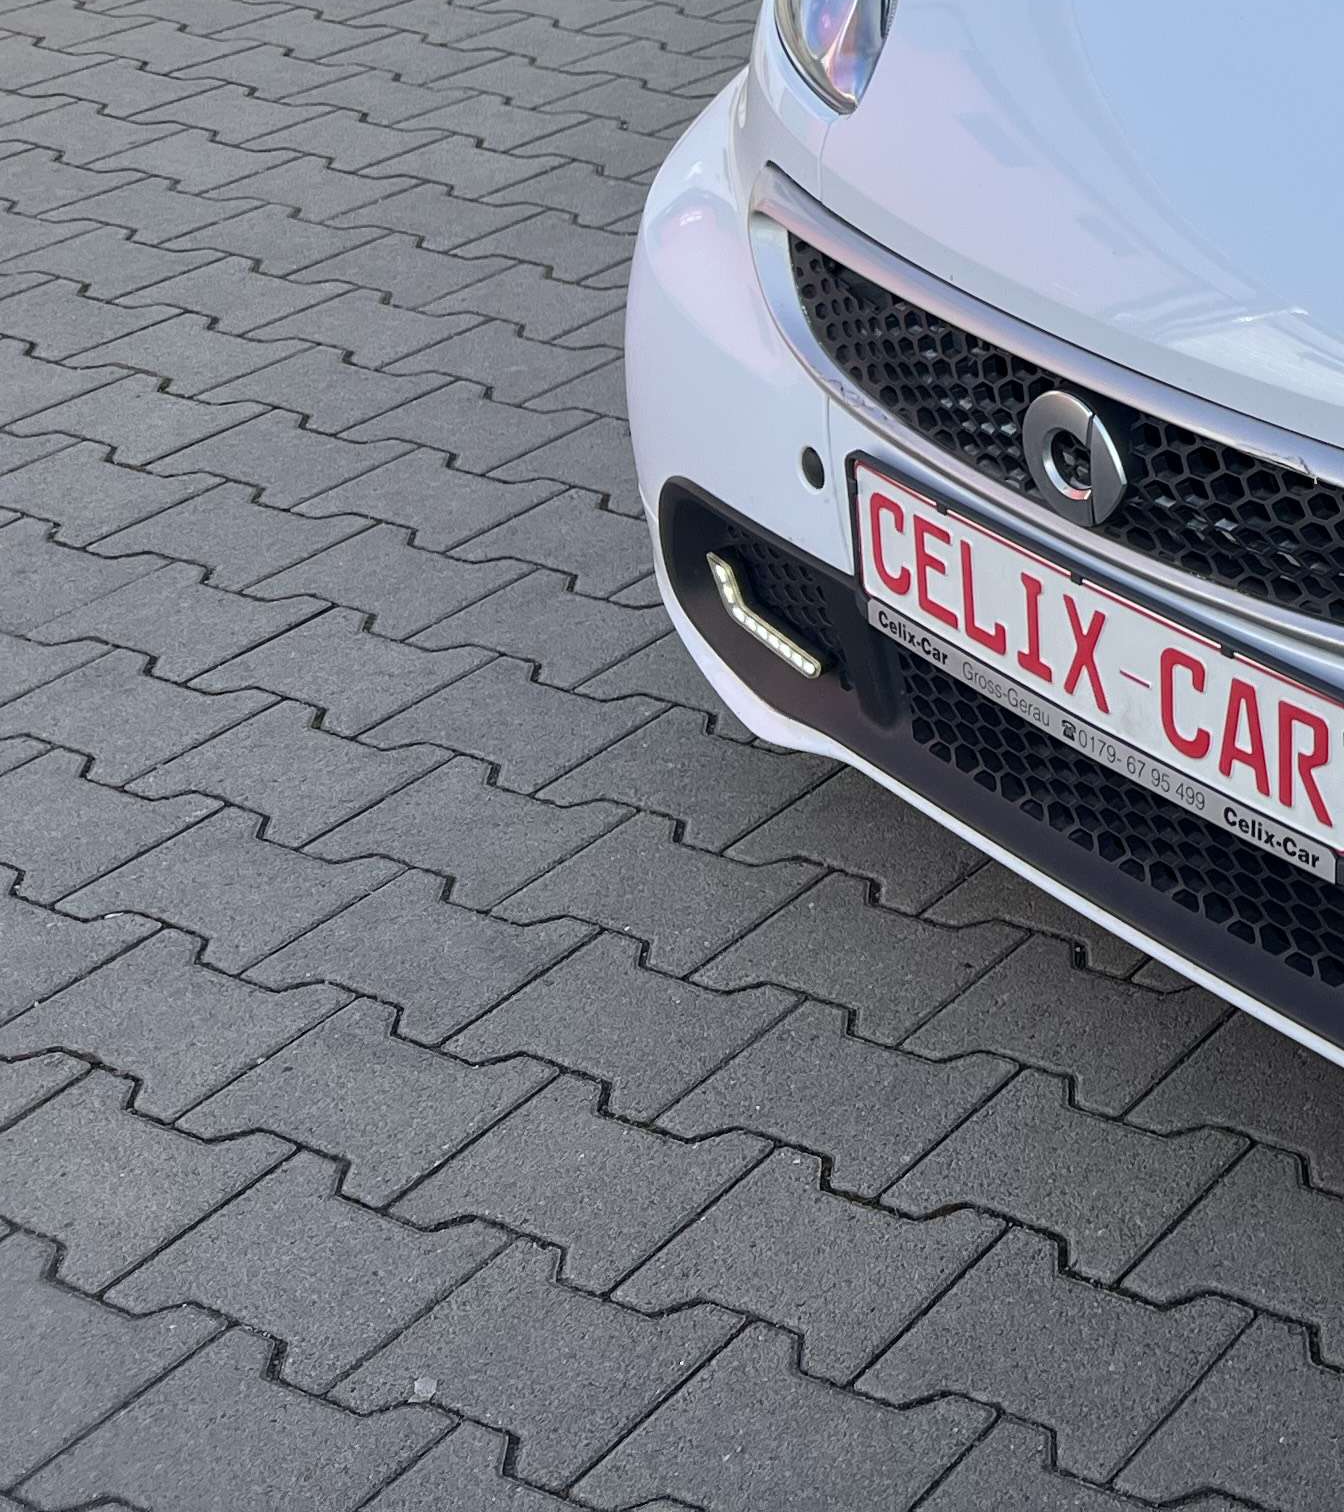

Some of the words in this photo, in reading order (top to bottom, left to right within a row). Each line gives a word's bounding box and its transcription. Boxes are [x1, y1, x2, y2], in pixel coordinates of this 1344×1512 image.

[870, 492, 1333, 828] CELIX-CAR
[878, 610, 949, 665] Celix-Car
[963, 661, 1050, 727] Gross-Gerau
[1126, 755, 1146, 777] 67
[1151, 768, 1170, 792] 95
[1175, 783, 1205, 810] 499
[1223, 806, 1319, 868] Celix-Car
